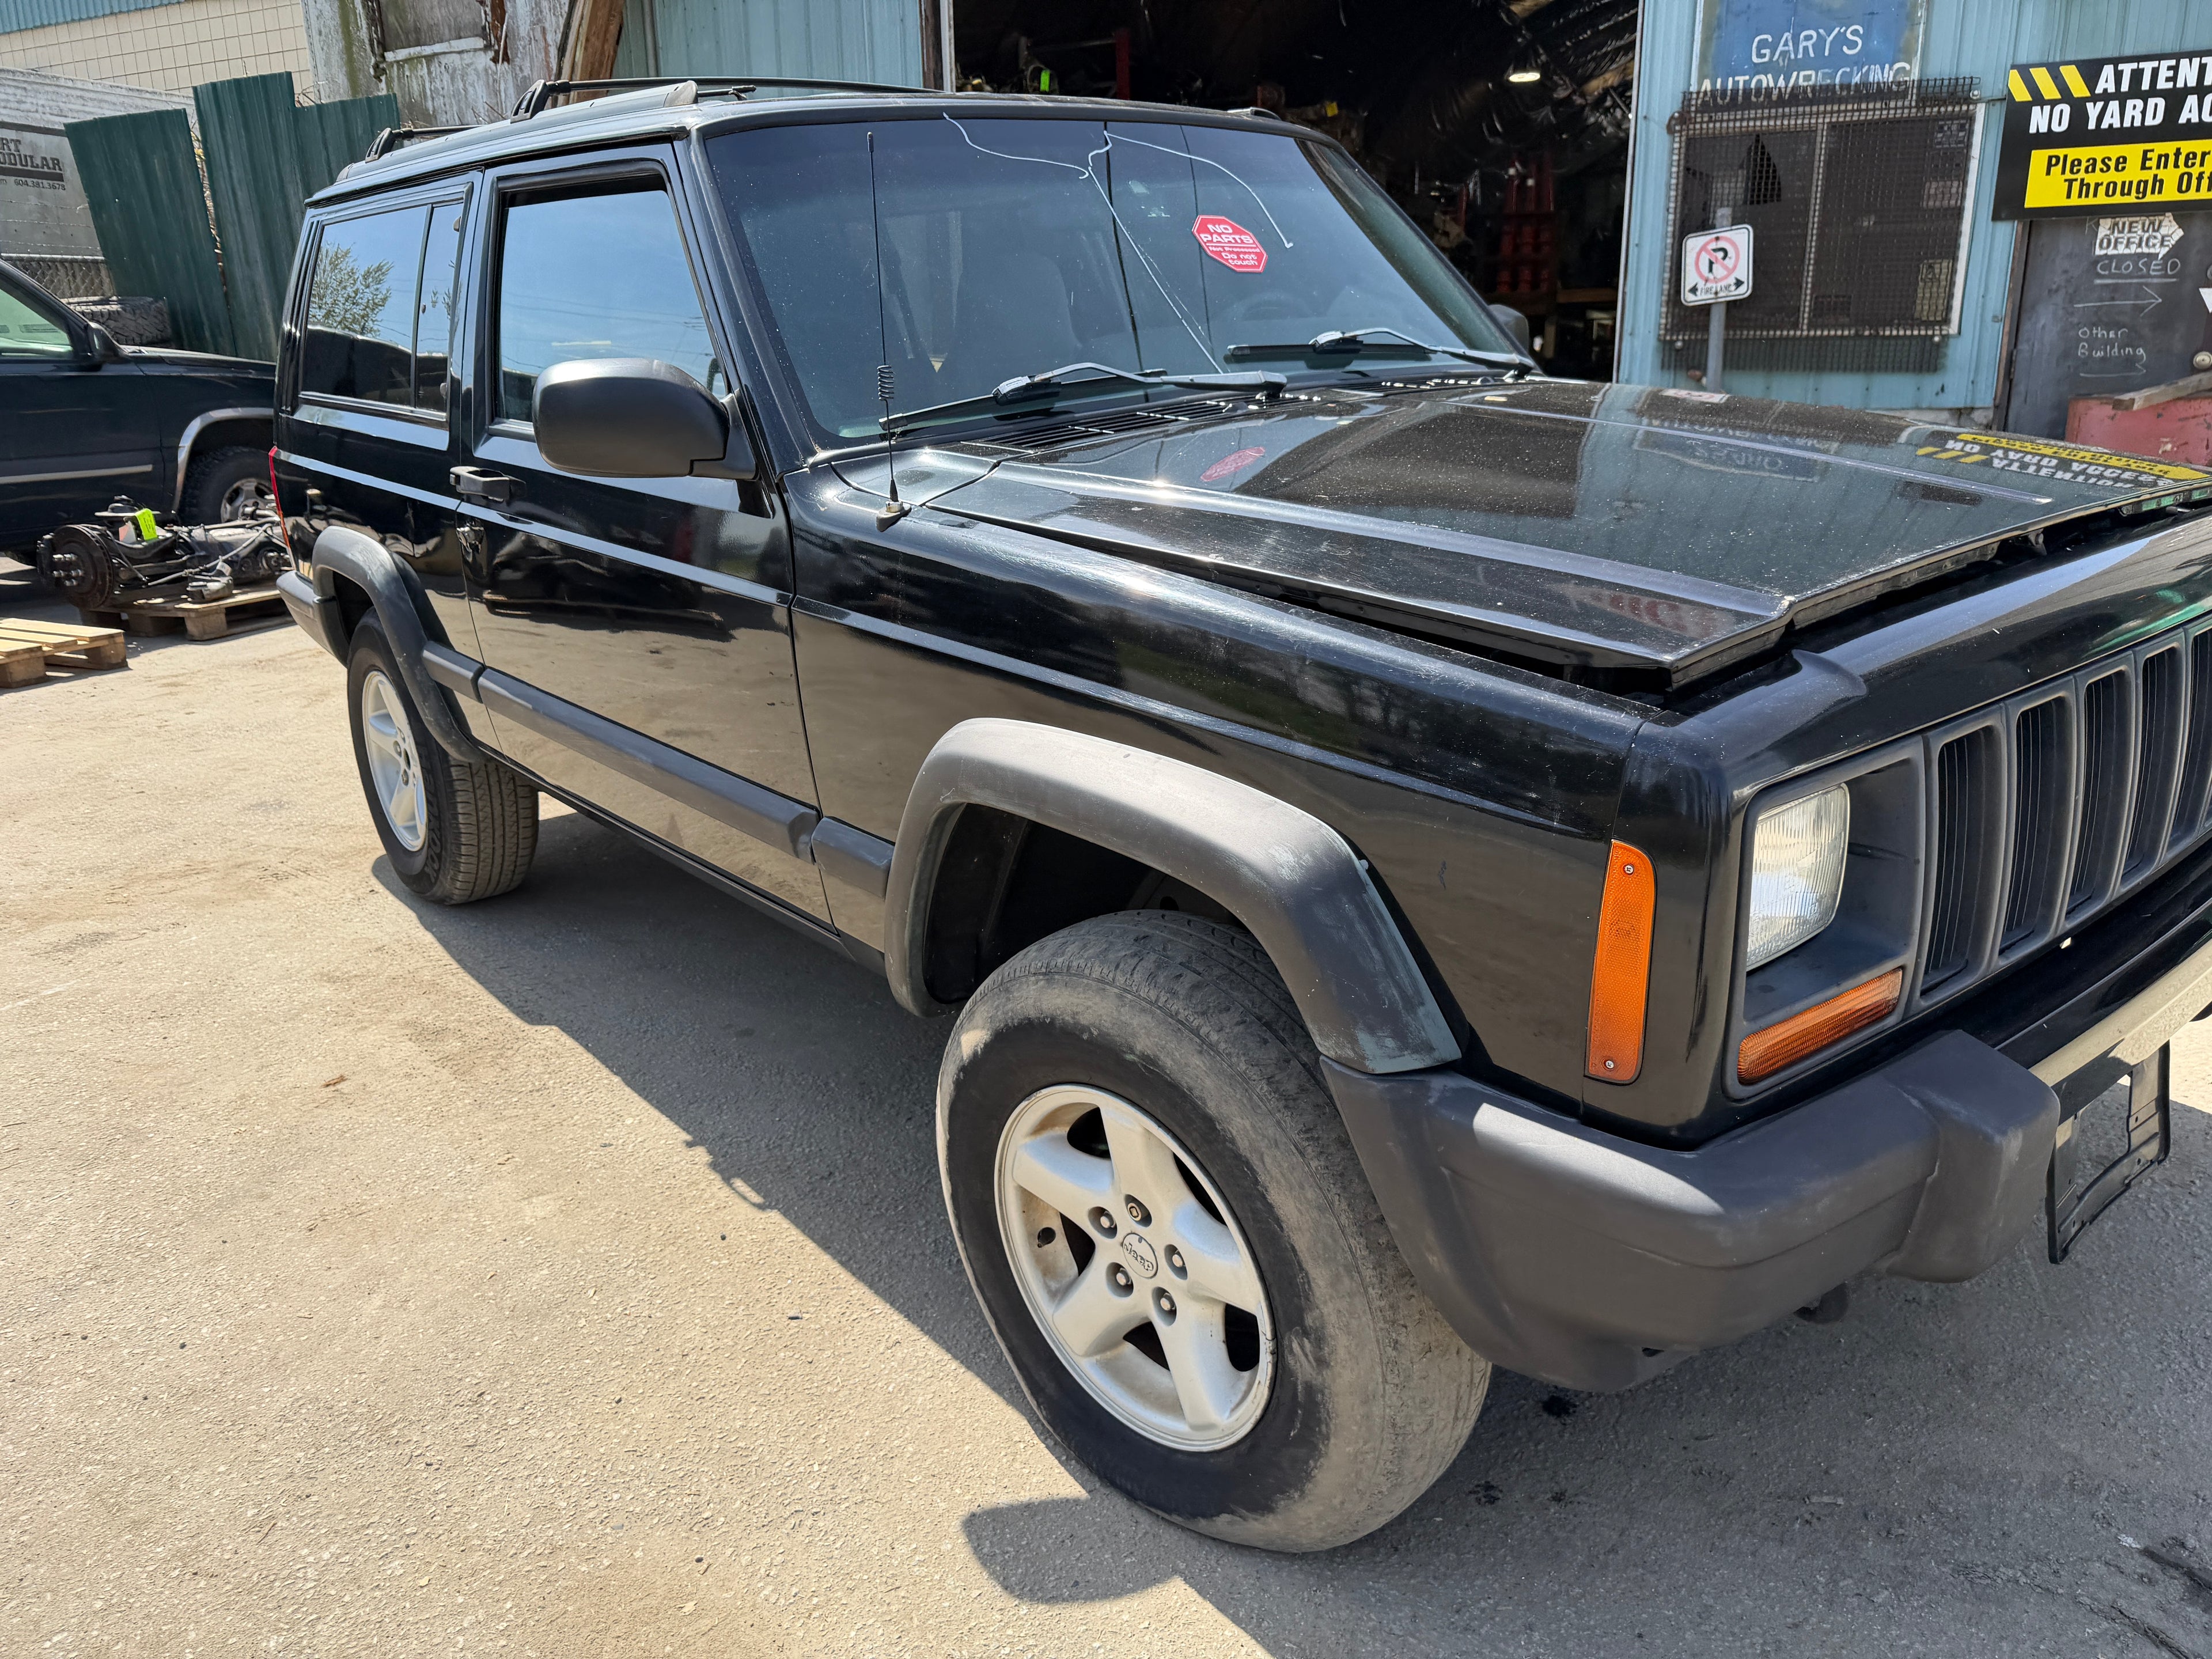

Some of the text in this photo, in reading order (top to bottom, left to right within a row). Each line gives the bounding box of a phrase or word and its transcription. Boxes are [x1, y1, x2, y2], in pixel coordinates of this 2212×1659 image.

[1751, 25, 1863, 63] GARY'S
[1698, 62, 1911, 106] AUTOWRECKING
[2029, 103, 2071, 134] NO
[2086, 97, 2165, 130] YARD
[2045, 147, 2211, 176] Please Enter
[2063, 173, 2165, 200] Through
[1207, 224, 1233, 233] NO
[2110, 219, 2162, 234] NEW
[1199, 233, 1254, 244] PARTS
[2099, 234, 2172, 250] OFFICE
[2097, 258, 2181, 275] CLOSED
[2078, 327, 2128, 339] Other
[2078, 342, 2146, 364] Building
[1124, 1243, 1154, 1271] Jeep
